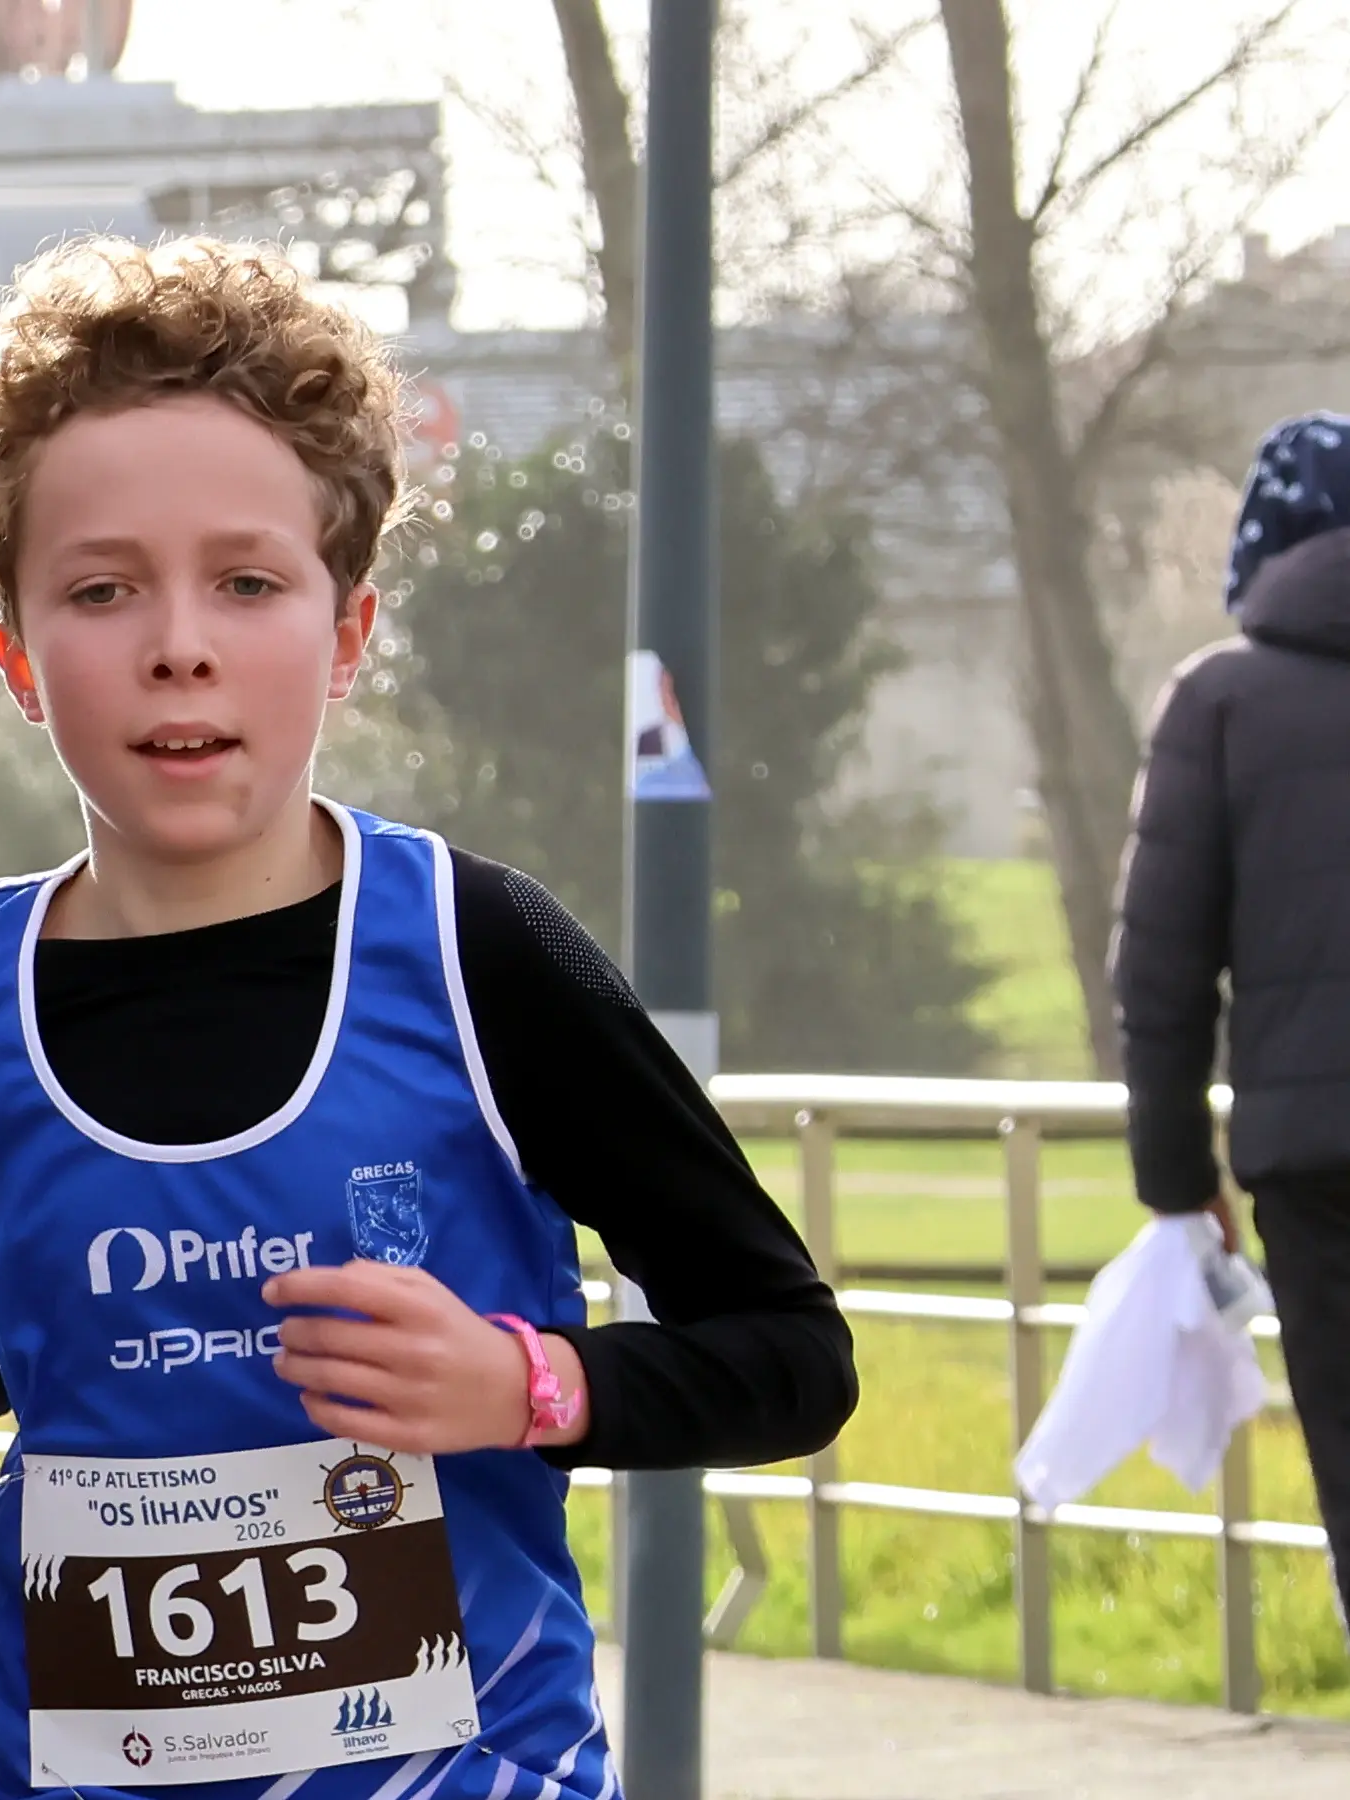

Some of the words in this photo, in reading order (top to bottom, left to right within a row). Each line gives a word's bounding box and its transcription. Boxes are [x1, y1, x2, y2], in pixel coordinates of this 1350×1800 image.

[351, 1161, 415, 1181] GRECAS
[76, 1470, 101, 1488] G.P
[105, 1466, 217, 1489] ATLETISMO
[88, 1498, 135, 1527] "OS
[235, 1520, 286, 1542] 2026
[88, 1547, 359, 1658] 1613
[135, 1661, 255, 1687] FRANCISCO
[260, 1651, 327, 1677] SILVA
[238, 1680, 282, 1695] VAGOS
[164, 1729, 269, 1753] S.Salvador
